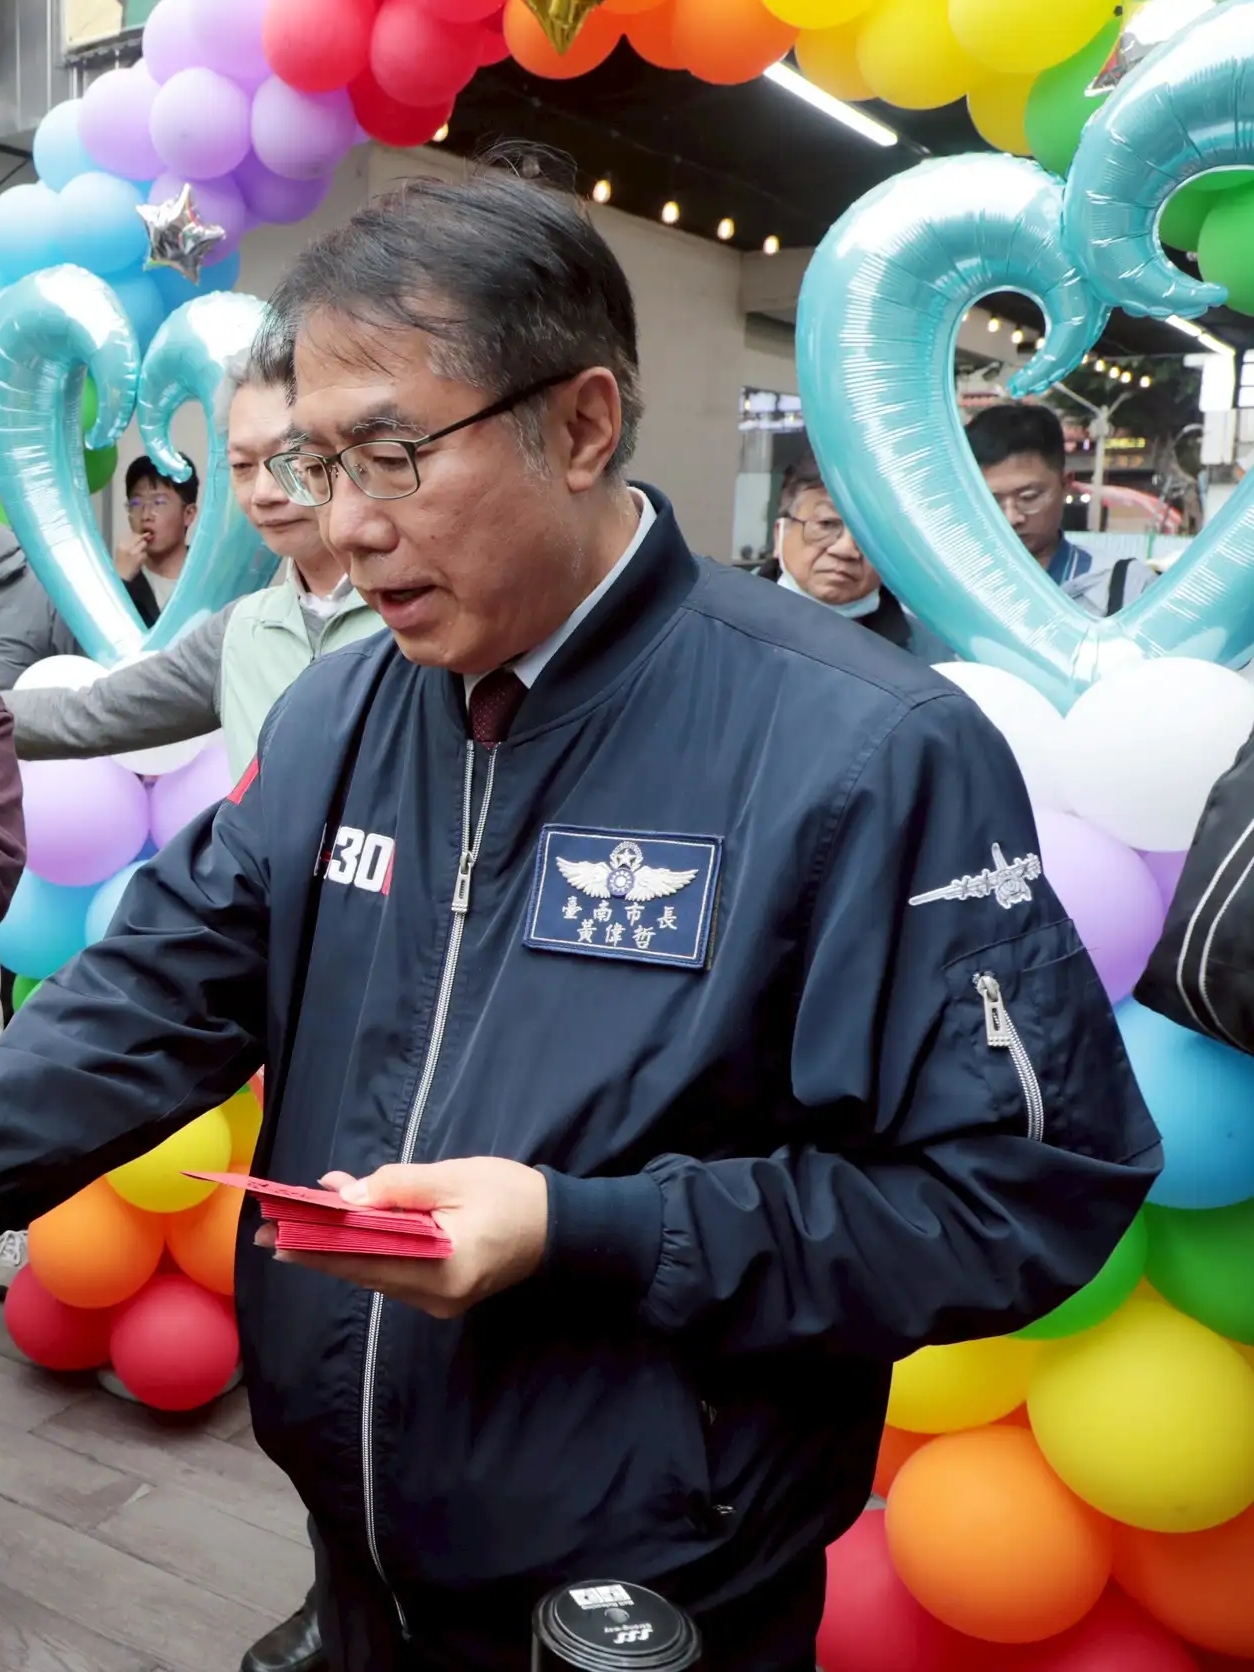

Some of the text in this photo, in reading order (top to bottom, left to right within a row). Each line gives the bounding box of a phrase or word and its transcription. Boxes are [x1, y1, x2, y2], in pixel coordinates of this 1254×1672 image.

[562, 896, 678, 930] 臺南市長
[577, 918, 657, 949] 黃偉哲
